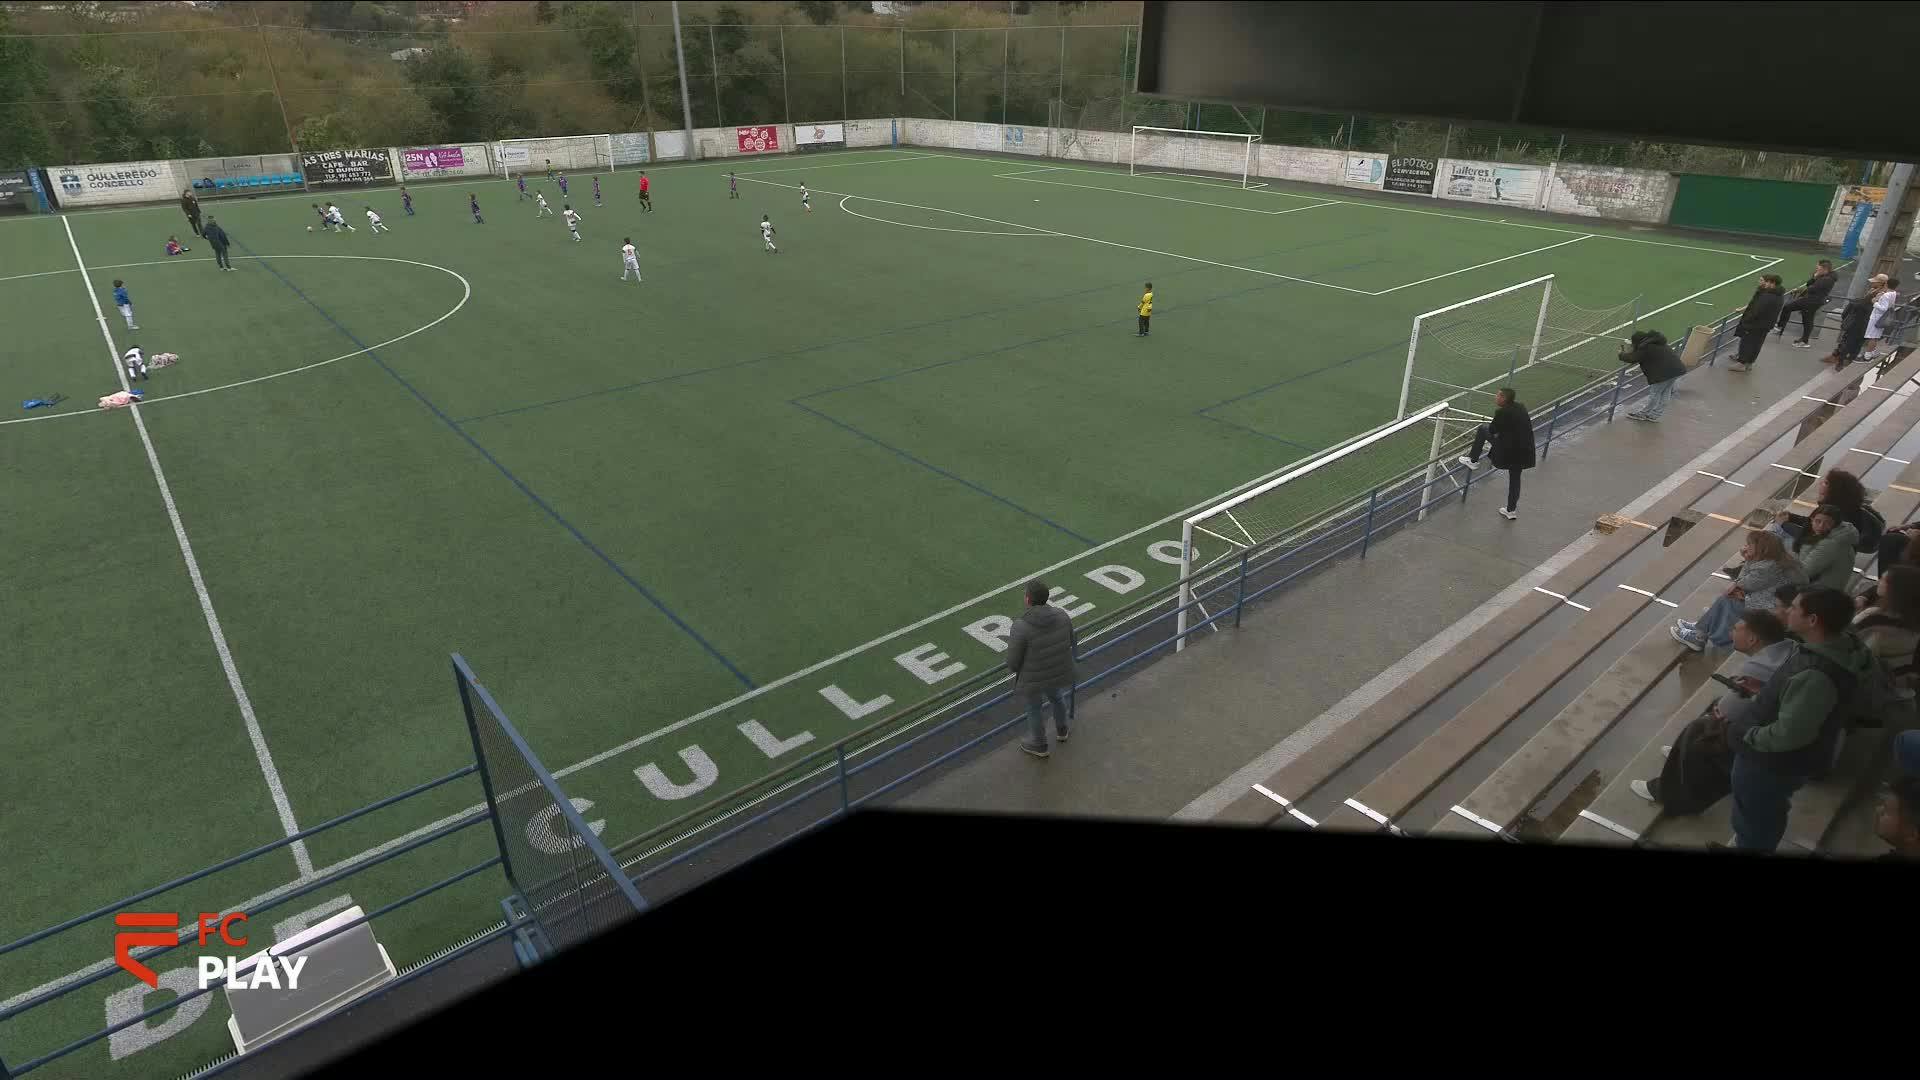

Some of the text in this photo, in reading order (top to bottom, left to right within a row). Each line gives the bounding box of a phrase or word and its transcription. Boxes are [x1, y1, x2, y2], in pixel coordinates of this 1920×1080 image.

[304, 149, 385, 167] AS TRES MARIAS
[405, 153, 424, 161] 25N
[1391, 158, 1434, 170] EL POTRO
